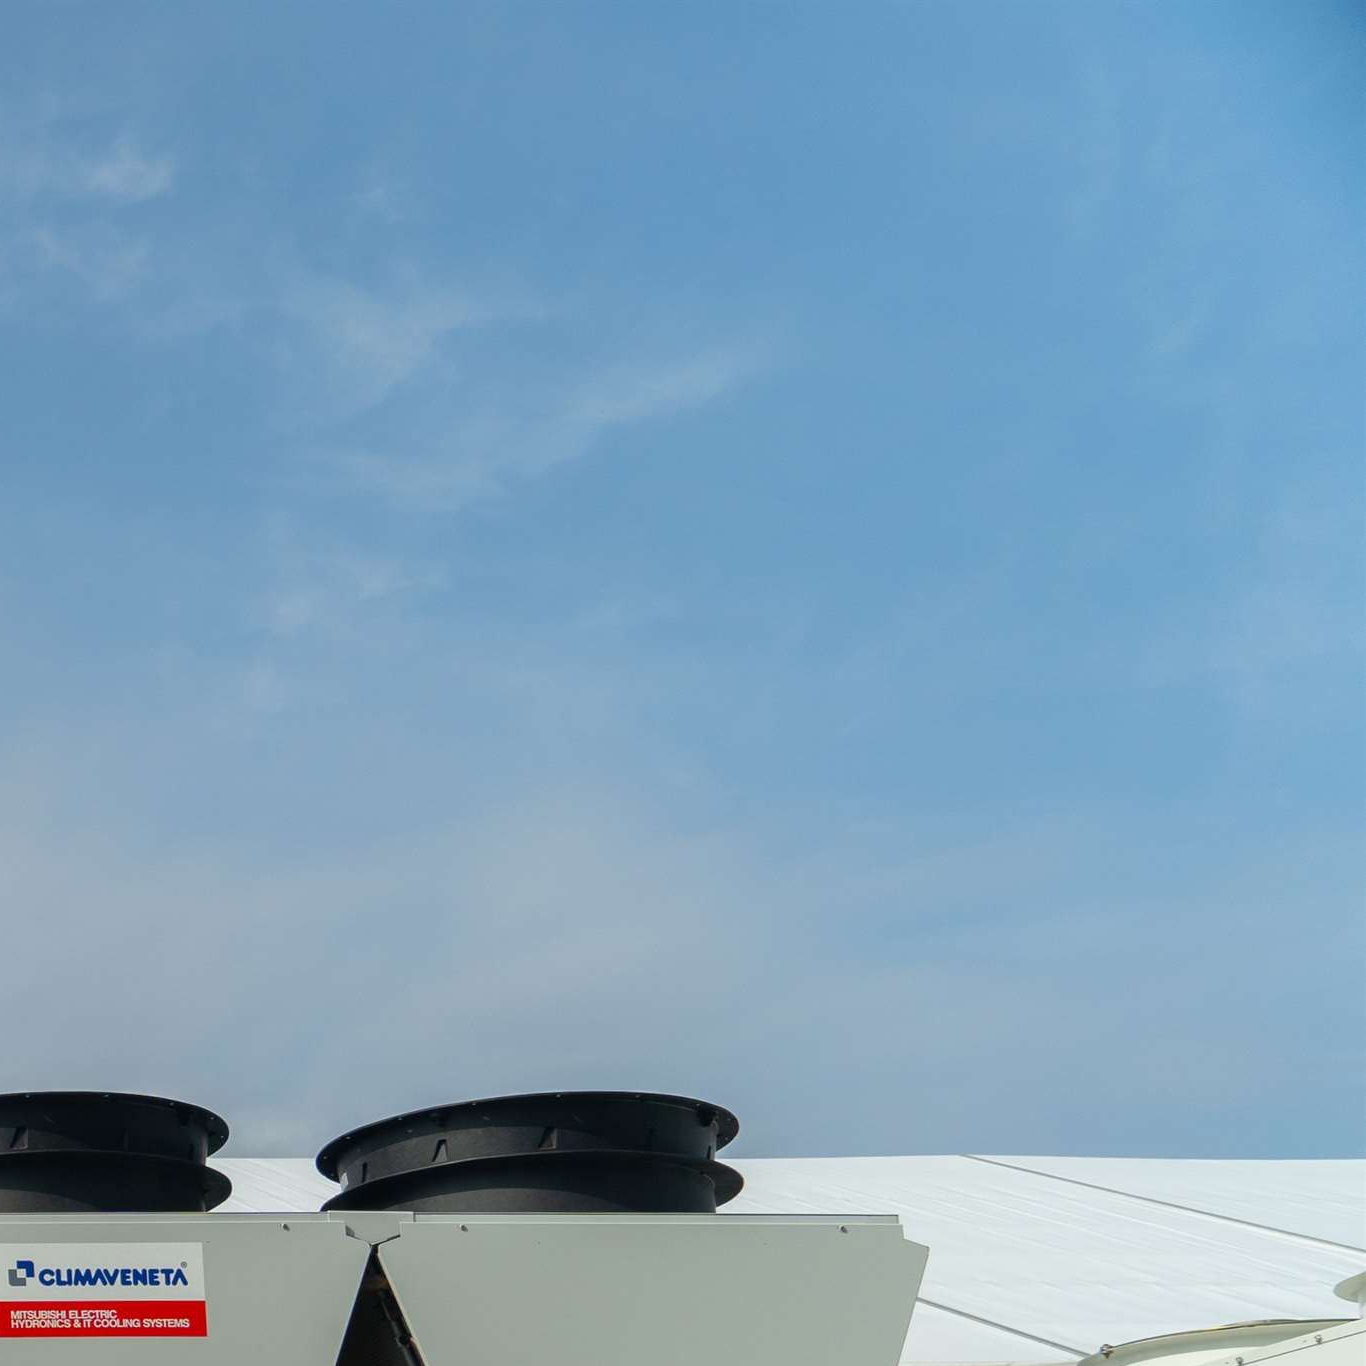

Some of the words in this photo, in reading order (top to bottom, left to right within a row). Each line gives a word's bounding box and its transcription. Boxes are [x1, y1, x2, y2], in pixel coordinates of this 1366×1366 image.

[38, 1268, 189, 1286] CLIMAVENETA
[10, 1310, 67, 1320] MITSUBISHI
[69, 1310, 118, 1319] ELECTRIC
[11, 1319, 71, 1329] HYDRONICS
[73, 1319, 82, 1328] &
[83, 1319, 93, 1328] IT
[94, 1319, 141, 1328] COOLING
[143, 1319, 190, 1328] SYSTEMS
